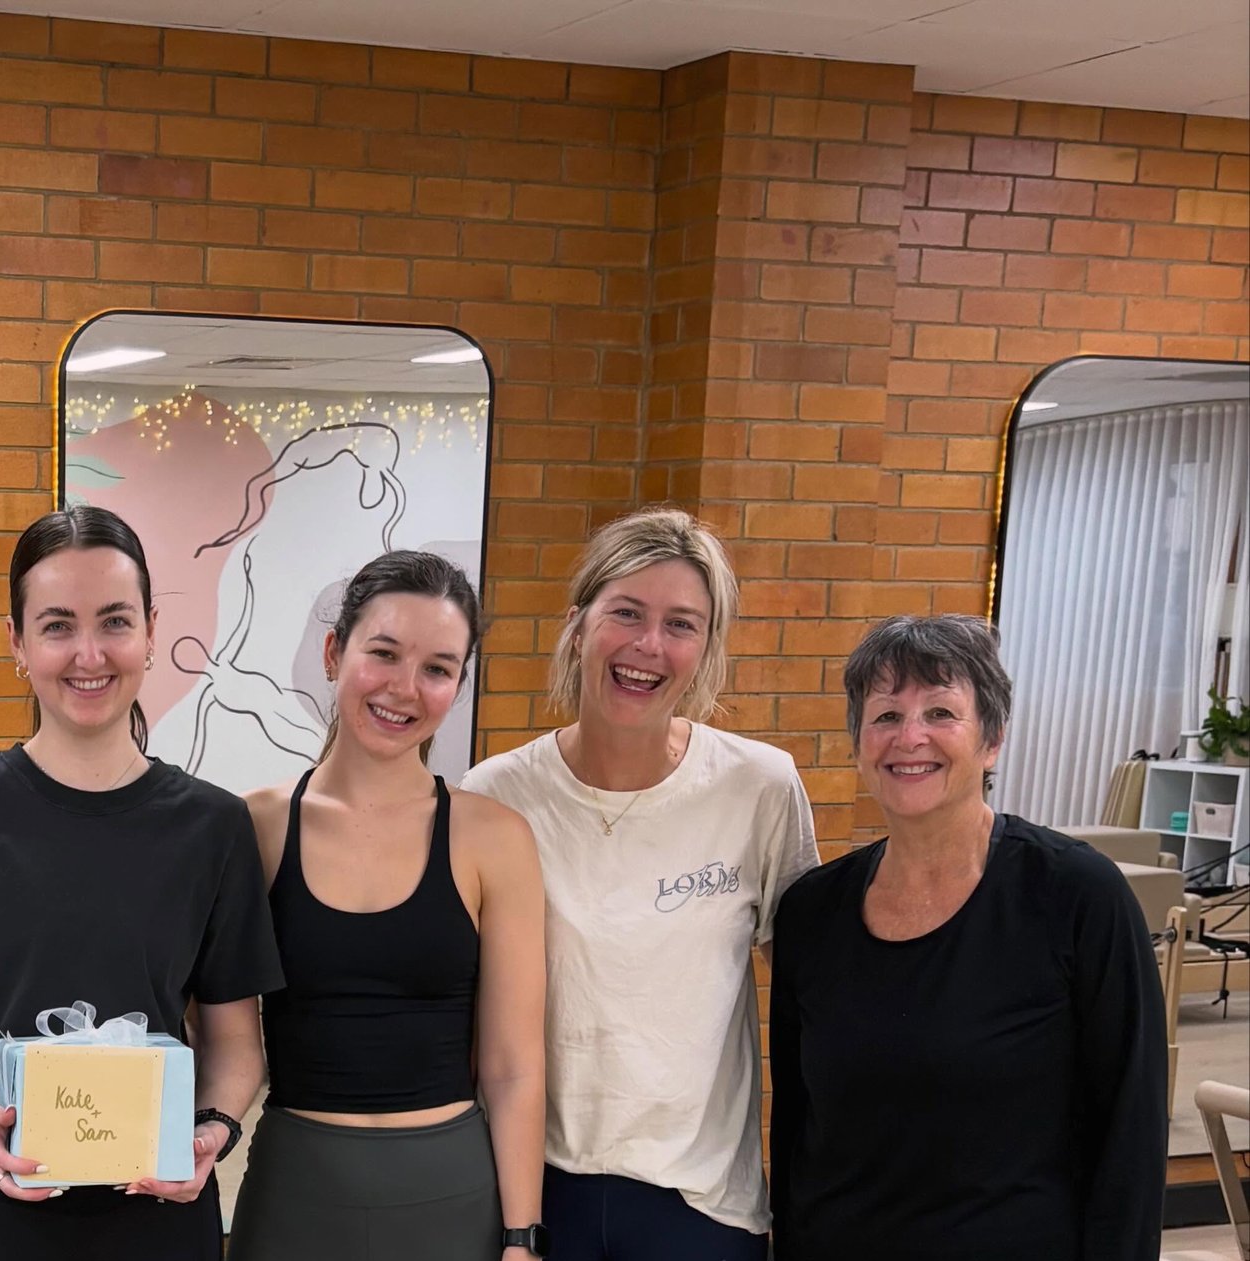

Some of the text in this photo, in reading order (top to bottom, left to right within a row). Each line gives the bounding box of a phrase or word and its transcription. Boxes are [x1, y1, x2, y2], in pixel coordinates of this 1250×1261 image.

[55, 1085, 95, 1110] Kate
[90, 1109, 102, 1119] +
[75, 1118, 118, 1142] Sam
